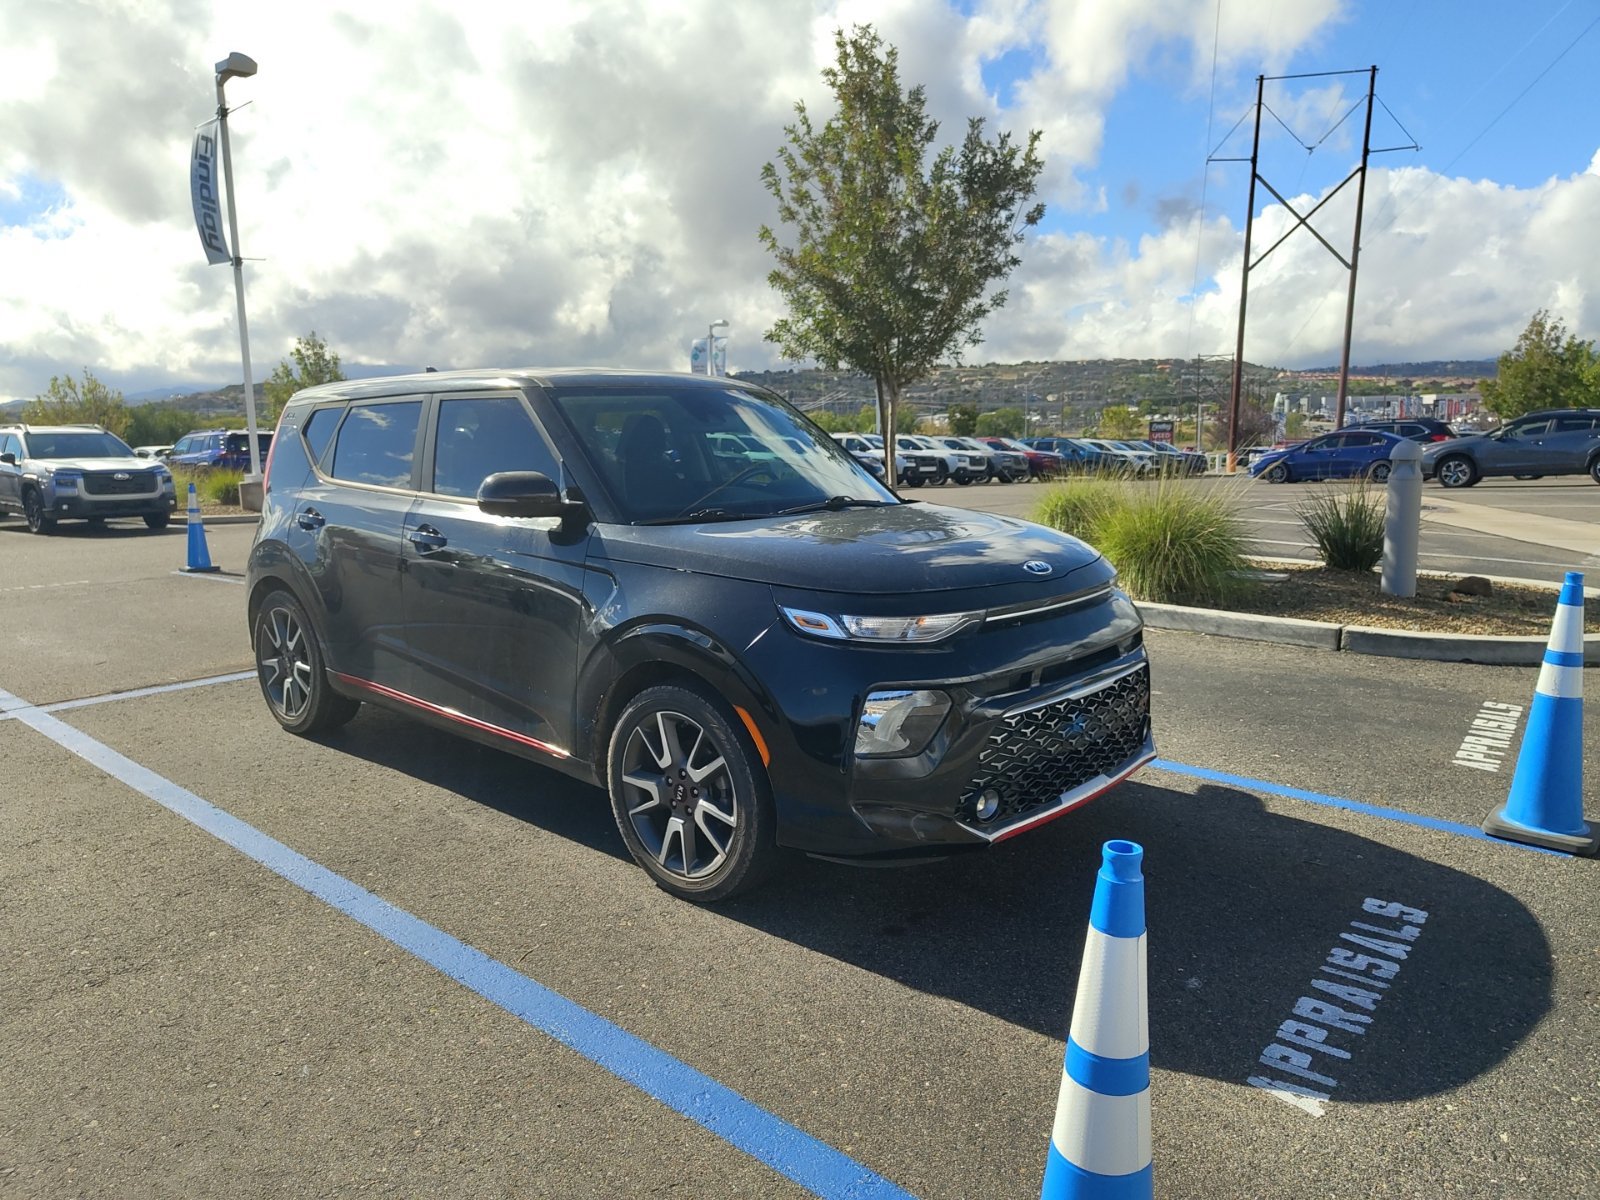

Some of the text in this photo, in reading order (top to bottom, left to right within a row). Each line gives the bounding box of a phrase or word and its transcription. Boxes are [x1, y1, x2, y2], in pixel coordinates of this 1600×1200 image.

[196, 134, 223, 253] Findlay
[1452, 701, 1523, 772] APPRAISALS
[676, 785, 684, 801] KIA
[1247, 897, 1429, 1118] APPRAISALS
